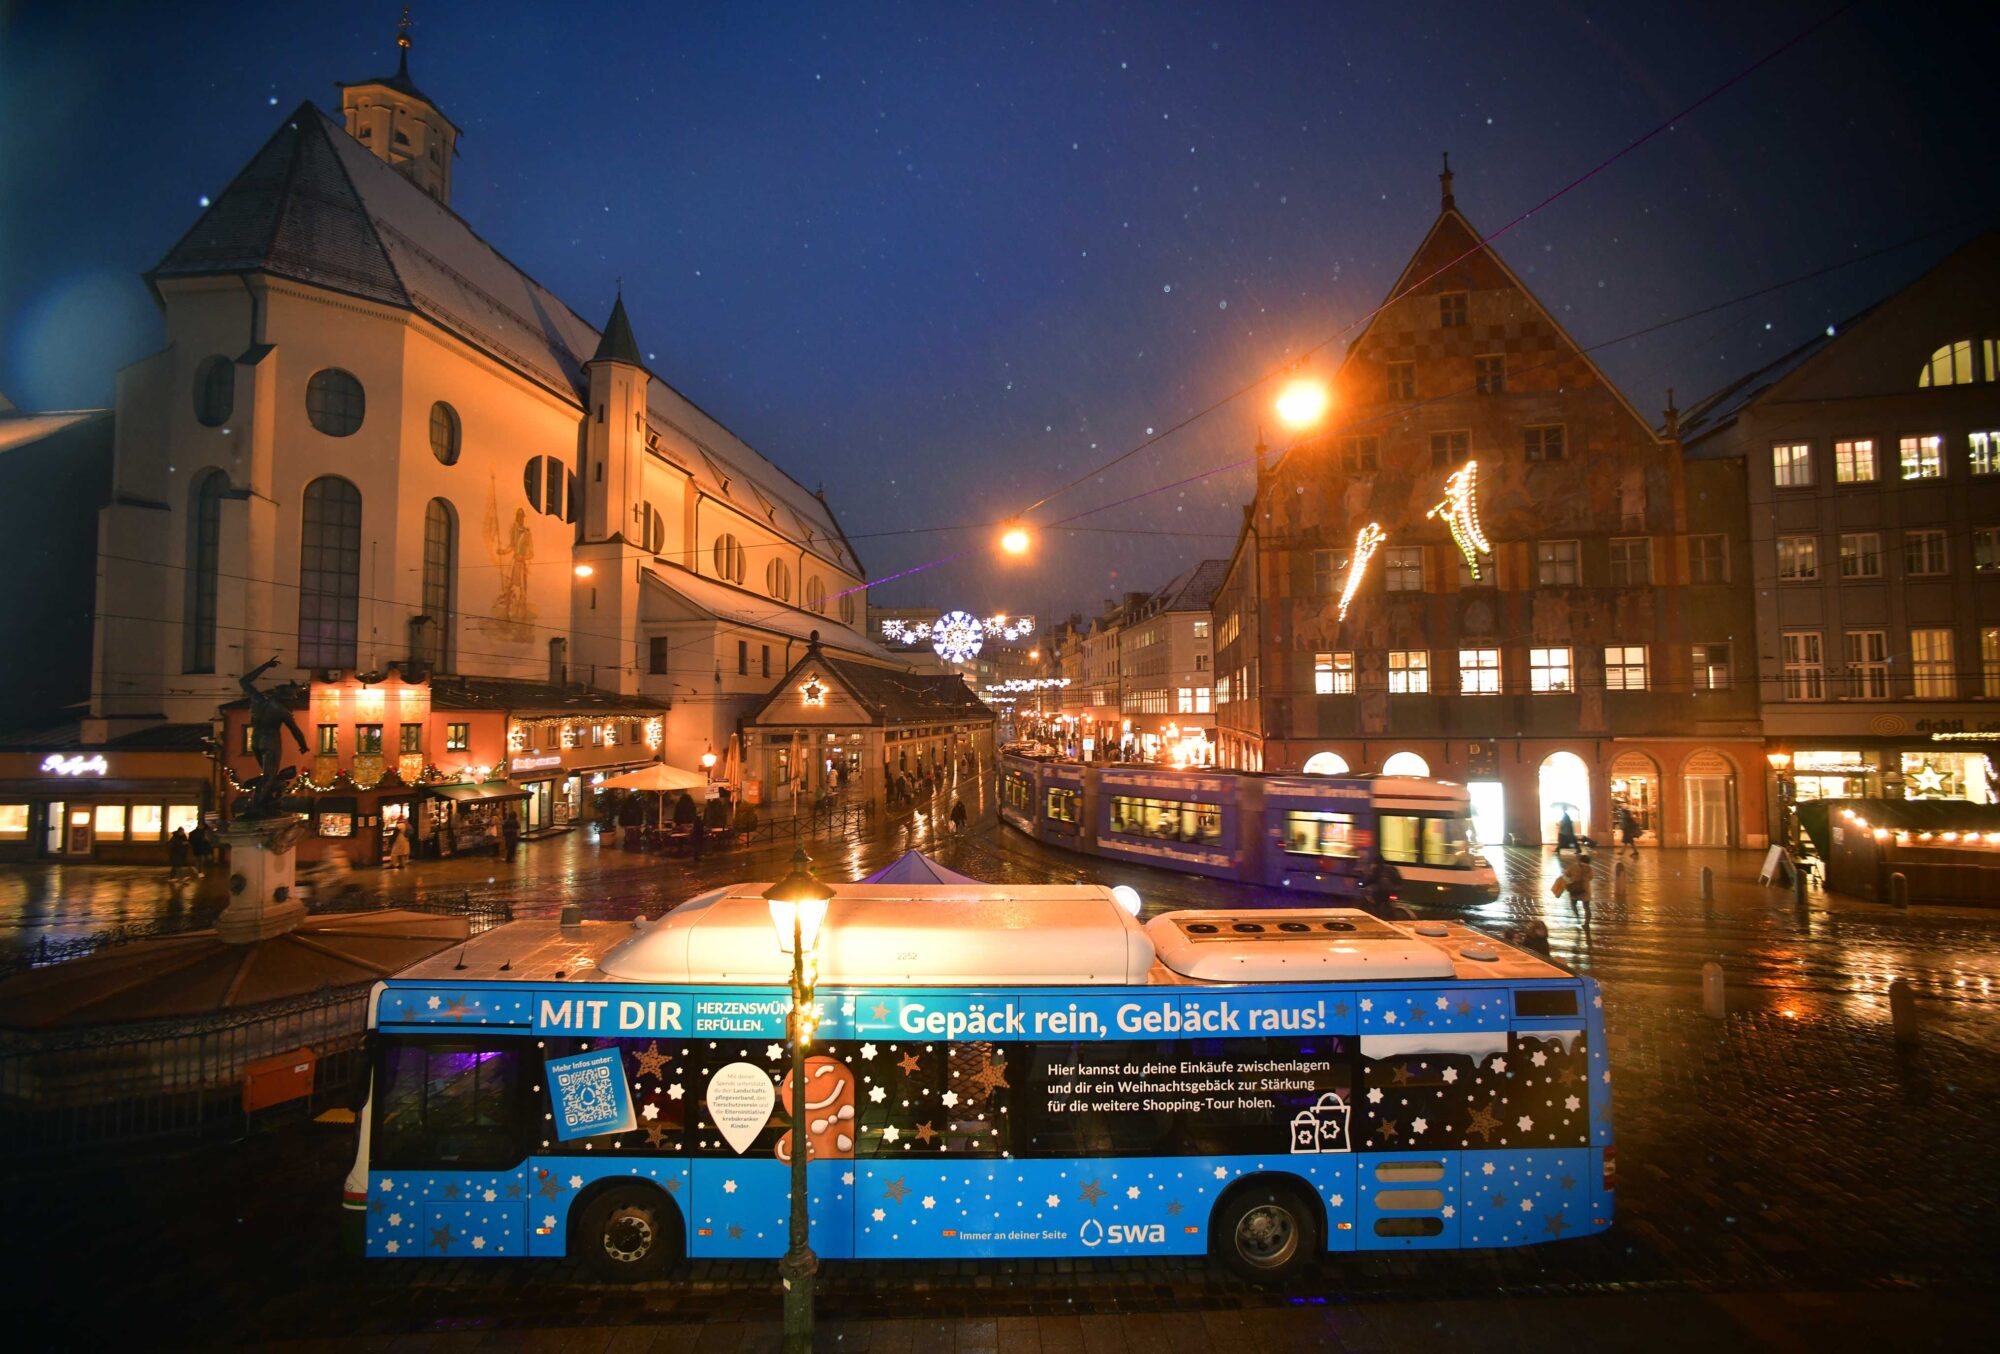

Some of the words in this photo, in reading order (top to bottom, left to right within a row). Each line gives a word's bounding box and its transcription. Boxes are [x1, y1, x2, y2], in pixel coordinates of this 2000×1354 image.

[540, 1000, 608, 1029] MIT
[619, 1001, 683, 1031] DIR
[697, 1000, 825, 1016] HERZENSWÜNE
[696, 1016, 764, 1032] ERFÜLLEN.
[899, 1003, 1024, 1039] Gepäck
[1035, 1003, 1107, 1038] rein,
[1116, 1002, 1240, 1033] Gebäck
[1249, 1000, 1326, 1031] raus!
[552, 1064, 571, 1073] Mehr
[572, 1060, 590, 1069] Infos
[591, 1056, 613, 1066] unter:
[1047, 1063, 1076, 1076] Hier
[1078, 1063, 1120, 1075] kannst
[1123, 1062, 1139, 1075] du
[1142, 1062, 1177, 1074] deine
[1180, 1061, 1234, 1074] Einkäufe
[1236, 1060, 1330, 1073] zwischenlagern
[1047, 1081, 1072, 1094] und
[1074, 1081, 1092, 1094] dir
[1095, 1082, 1114, 1093] ein
[1117, 1079, 1235, 1094] Weihnachtsgebäck
[1237, 1081, 1257, 1091] zur
[1260, 1078, 1315, 1092] Stärkung
[1047, 1100, 1066, 1112] für
[1069, 1099, 1089, 1112] die
[1091, 1099, 1140, 1112] weitere
[1142, 1097, 1235, 1113] Shopping-Tour
[1237, 1096, 1276, 1109] holen.
[959, 1231, 991, 1240] Immer
[1008, 1231, 1039, 1240] deiner
[1042, 1230, 1067, 1240] Seite
[1107, 1224, 1166, 1244] swa
